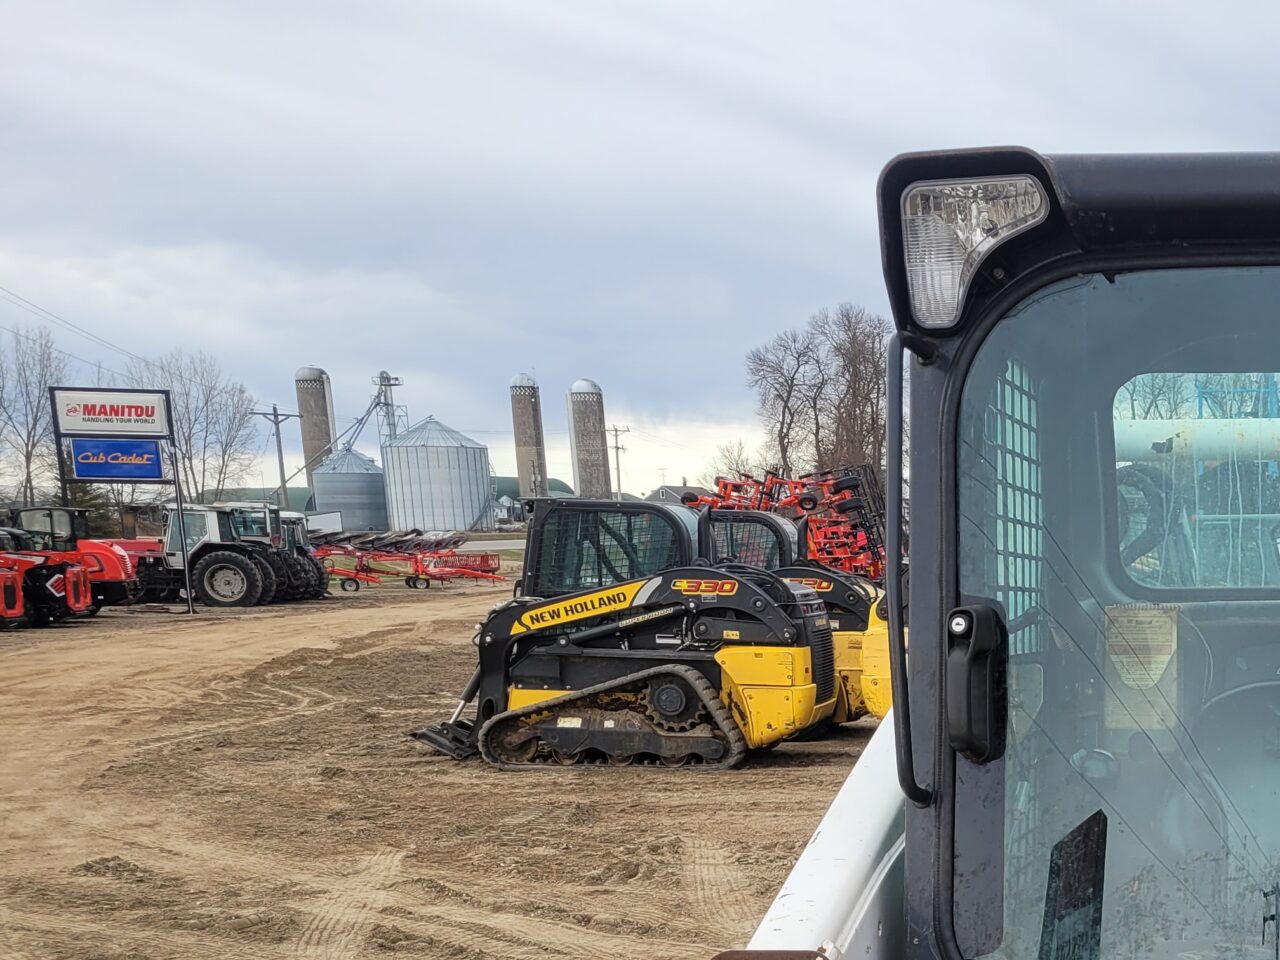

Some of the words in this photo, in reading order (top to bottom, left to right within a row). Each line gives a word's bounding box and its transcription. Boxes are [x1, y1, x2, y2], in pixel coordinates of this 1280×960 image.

[82, 404, 155, 417] MANITOU
[77, 452, 106, 464] Cub
[107, 452, 155, 464] Cadet
[529, 607, 561, 625] NEW
[563, 591, 627, 616] HOLLAND
